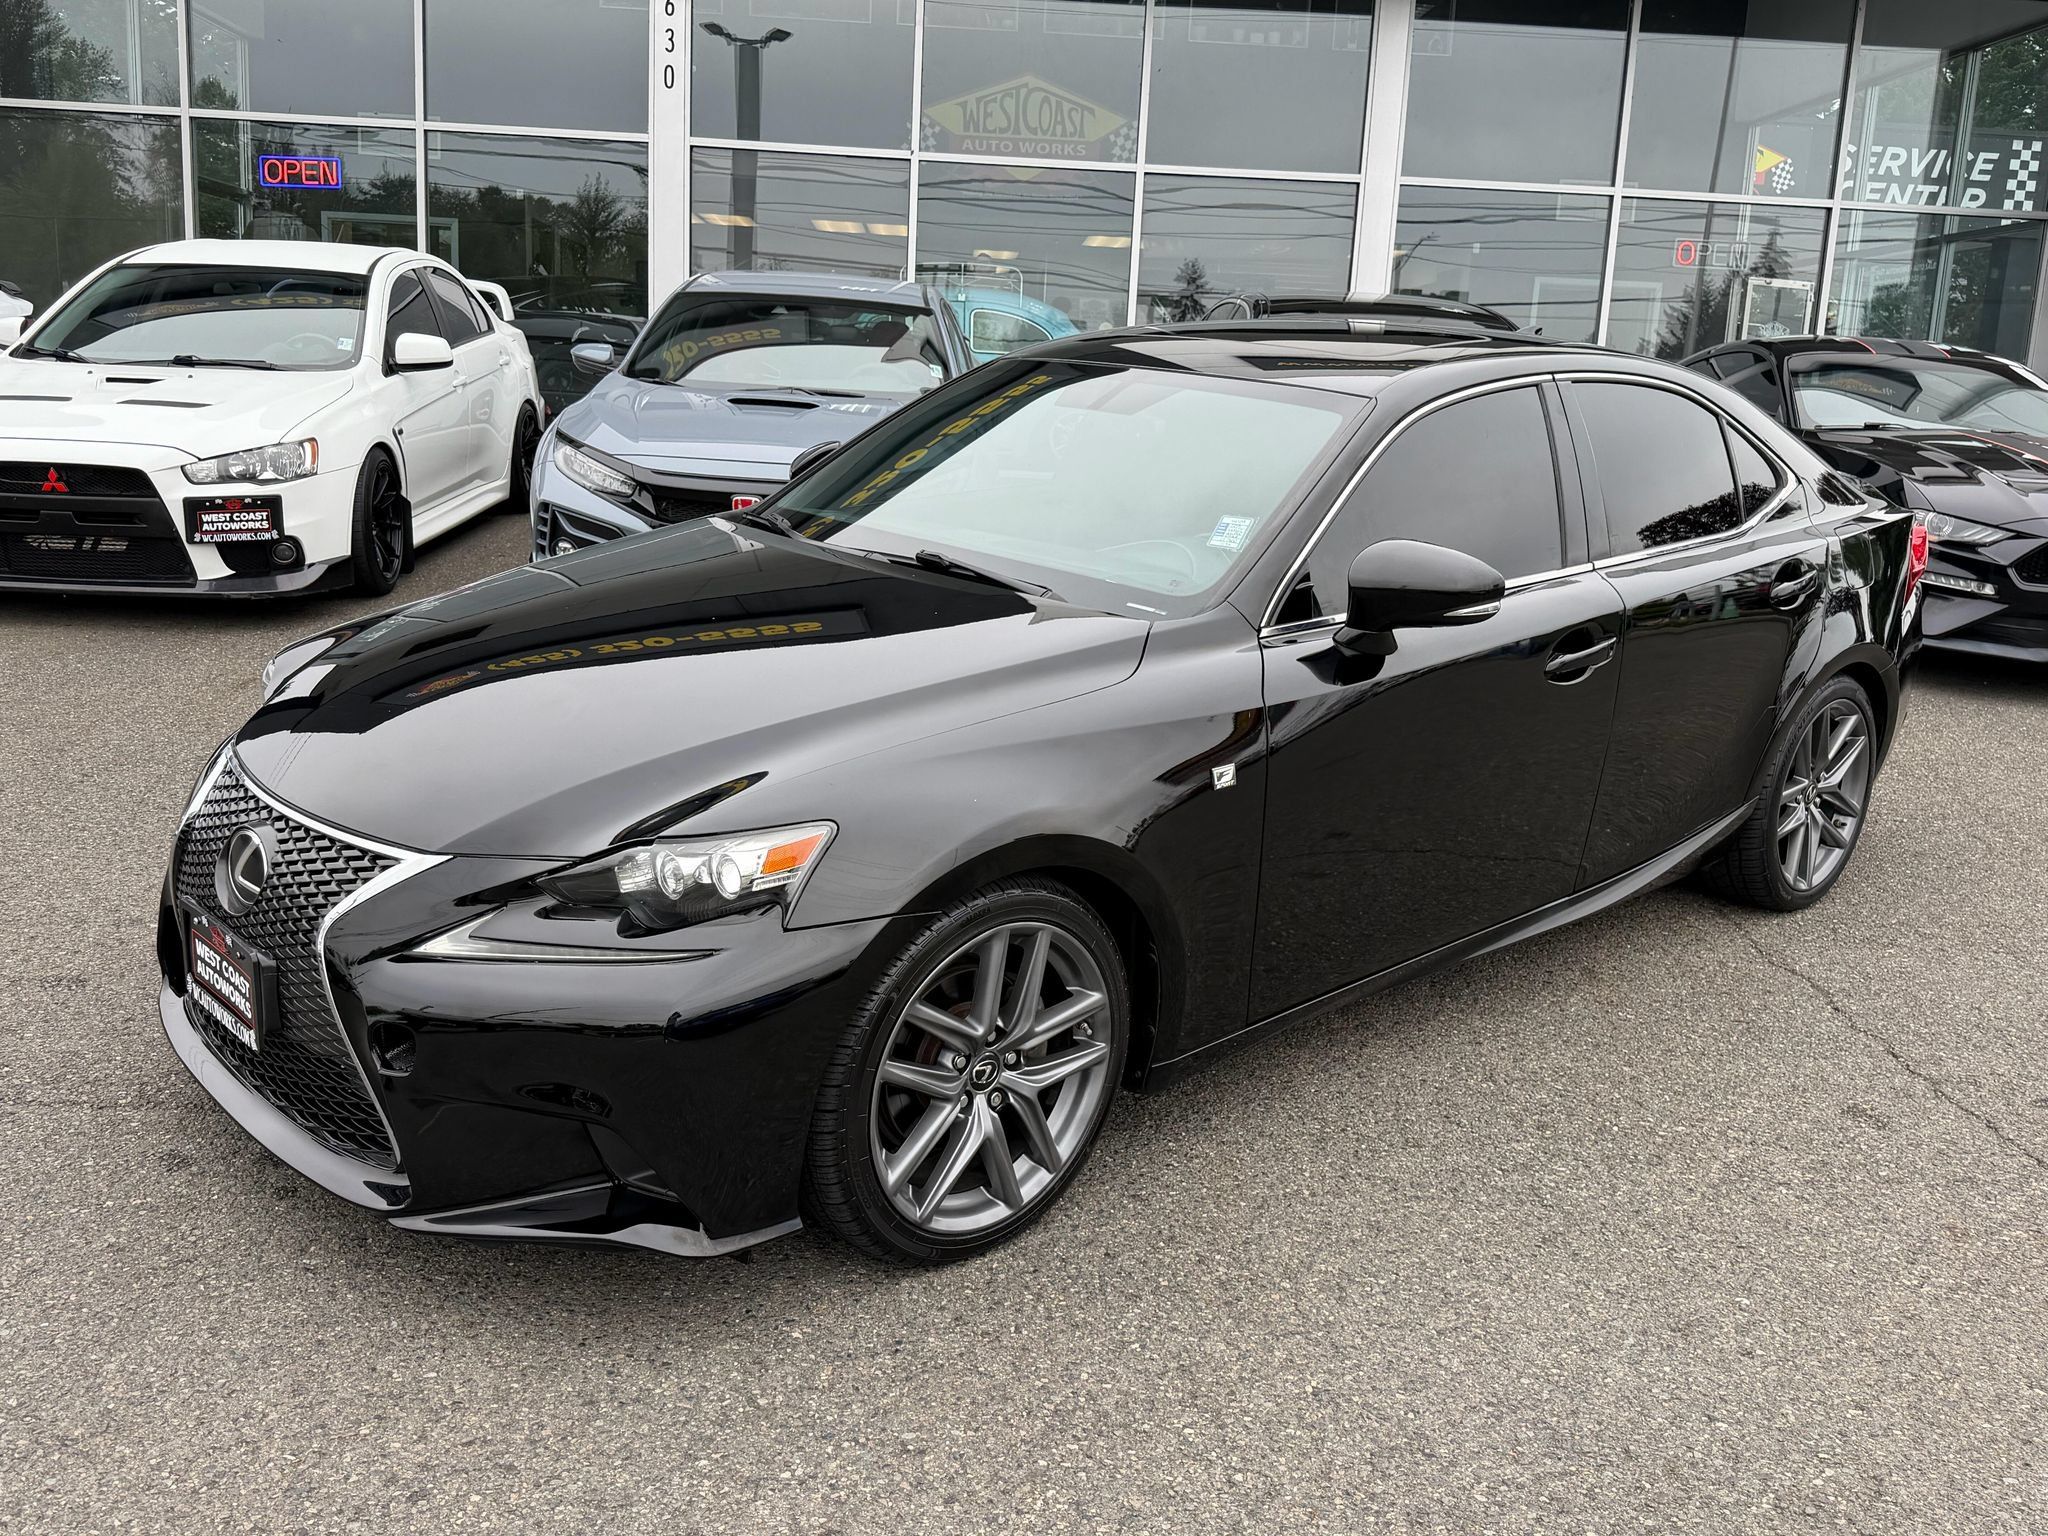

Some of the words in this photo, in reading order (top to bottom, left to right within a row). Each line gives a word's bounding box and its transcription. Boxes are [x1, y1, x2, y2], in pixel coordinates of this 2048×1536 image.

[962, 138, 1013, 151] AUTO
[1019, 141, 1086, 156] WORKS
[264, 159, 338, 185] OPEN
[1841, 181, 1987, 209] ENTR
[1677, 240, 1748, 270] OPEN
[201, 513, 231, 522] WEST
[232, 511, 268, 521] COAST
[202, 520, 269, 531] AUTOWORKS
[201, 531, 272, 543] WCAUTOWORKS.COM
[195, 938, 221, 971] WEST
[222, 960, 250, 998] COAST
[197, 959, 252, 1019] AUTOWORKS
[192, 982, 251, 1047] WCAUTOWORKS.COM
